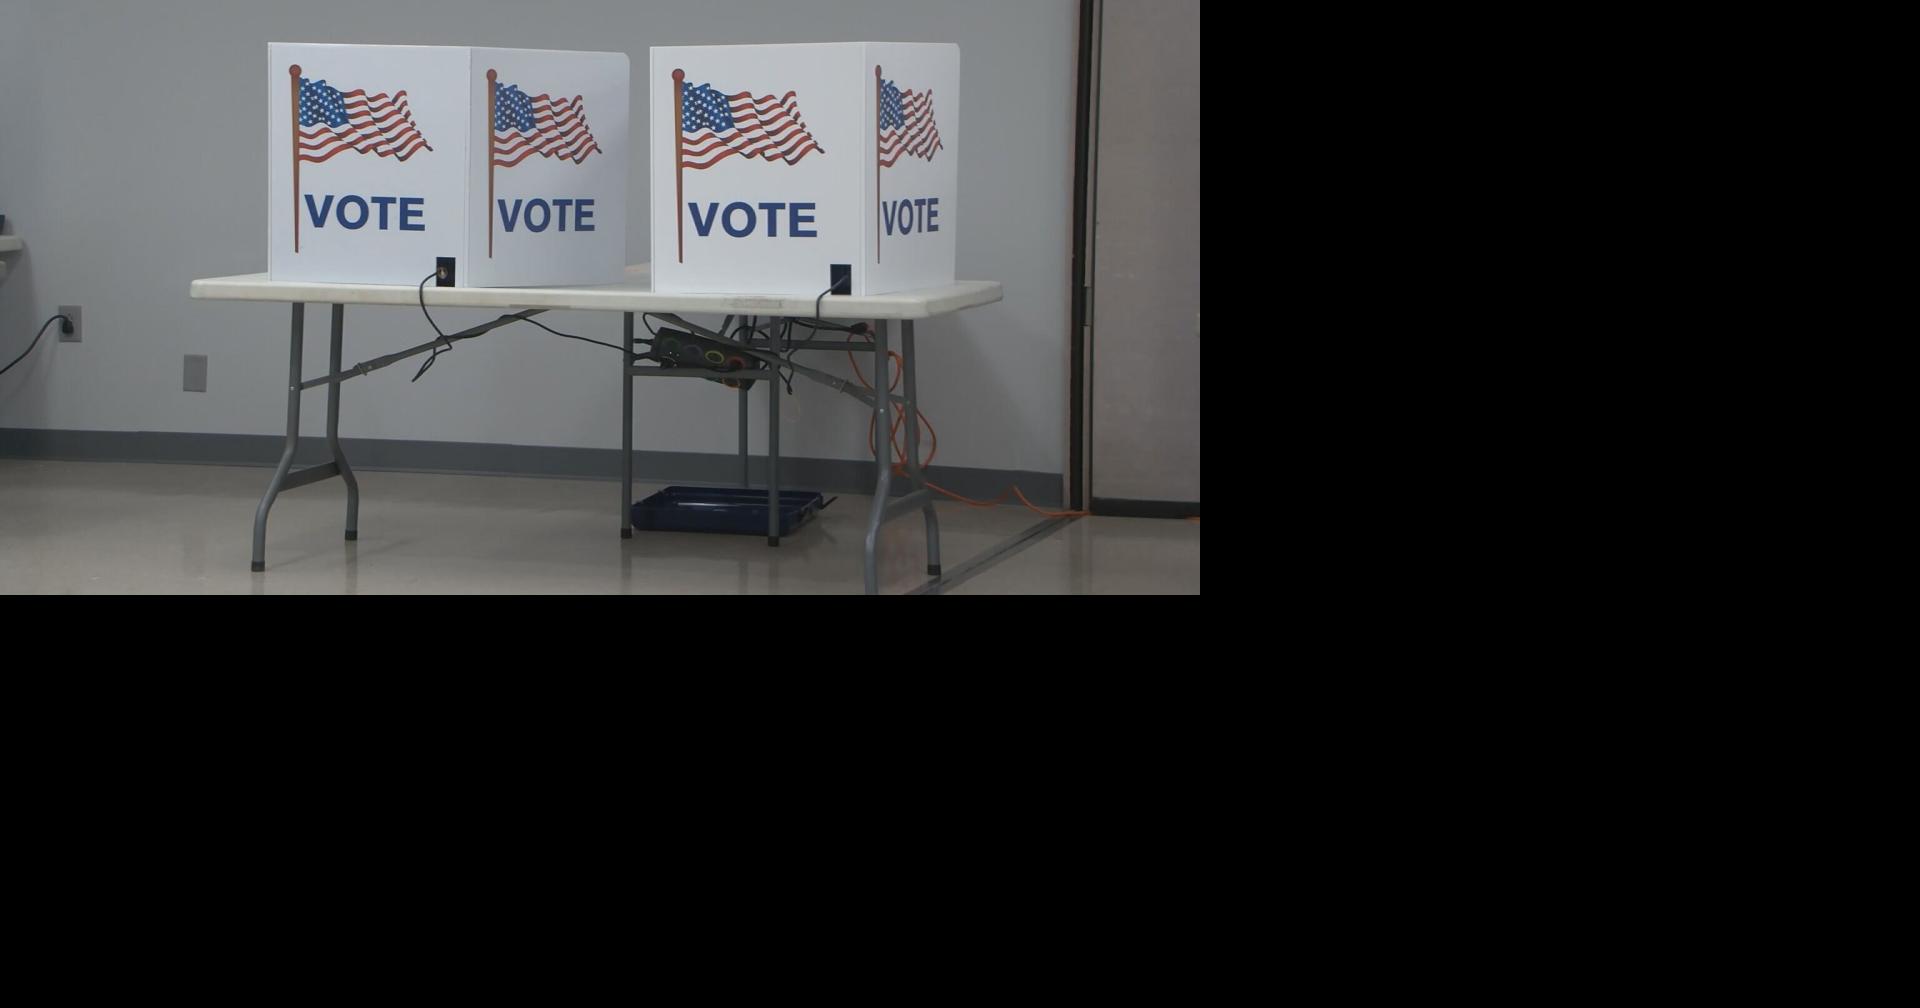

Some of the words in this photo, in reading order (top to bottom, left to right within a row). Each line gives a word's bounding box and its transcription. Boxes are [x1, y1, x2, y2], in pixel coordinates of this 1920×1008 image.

[304, 195, 426, 232] VOTE
[498, 198, 595, 233] VOTE
[688, 201, 818, 238] VOTE
[882, 198, 939, 236] VOTE
